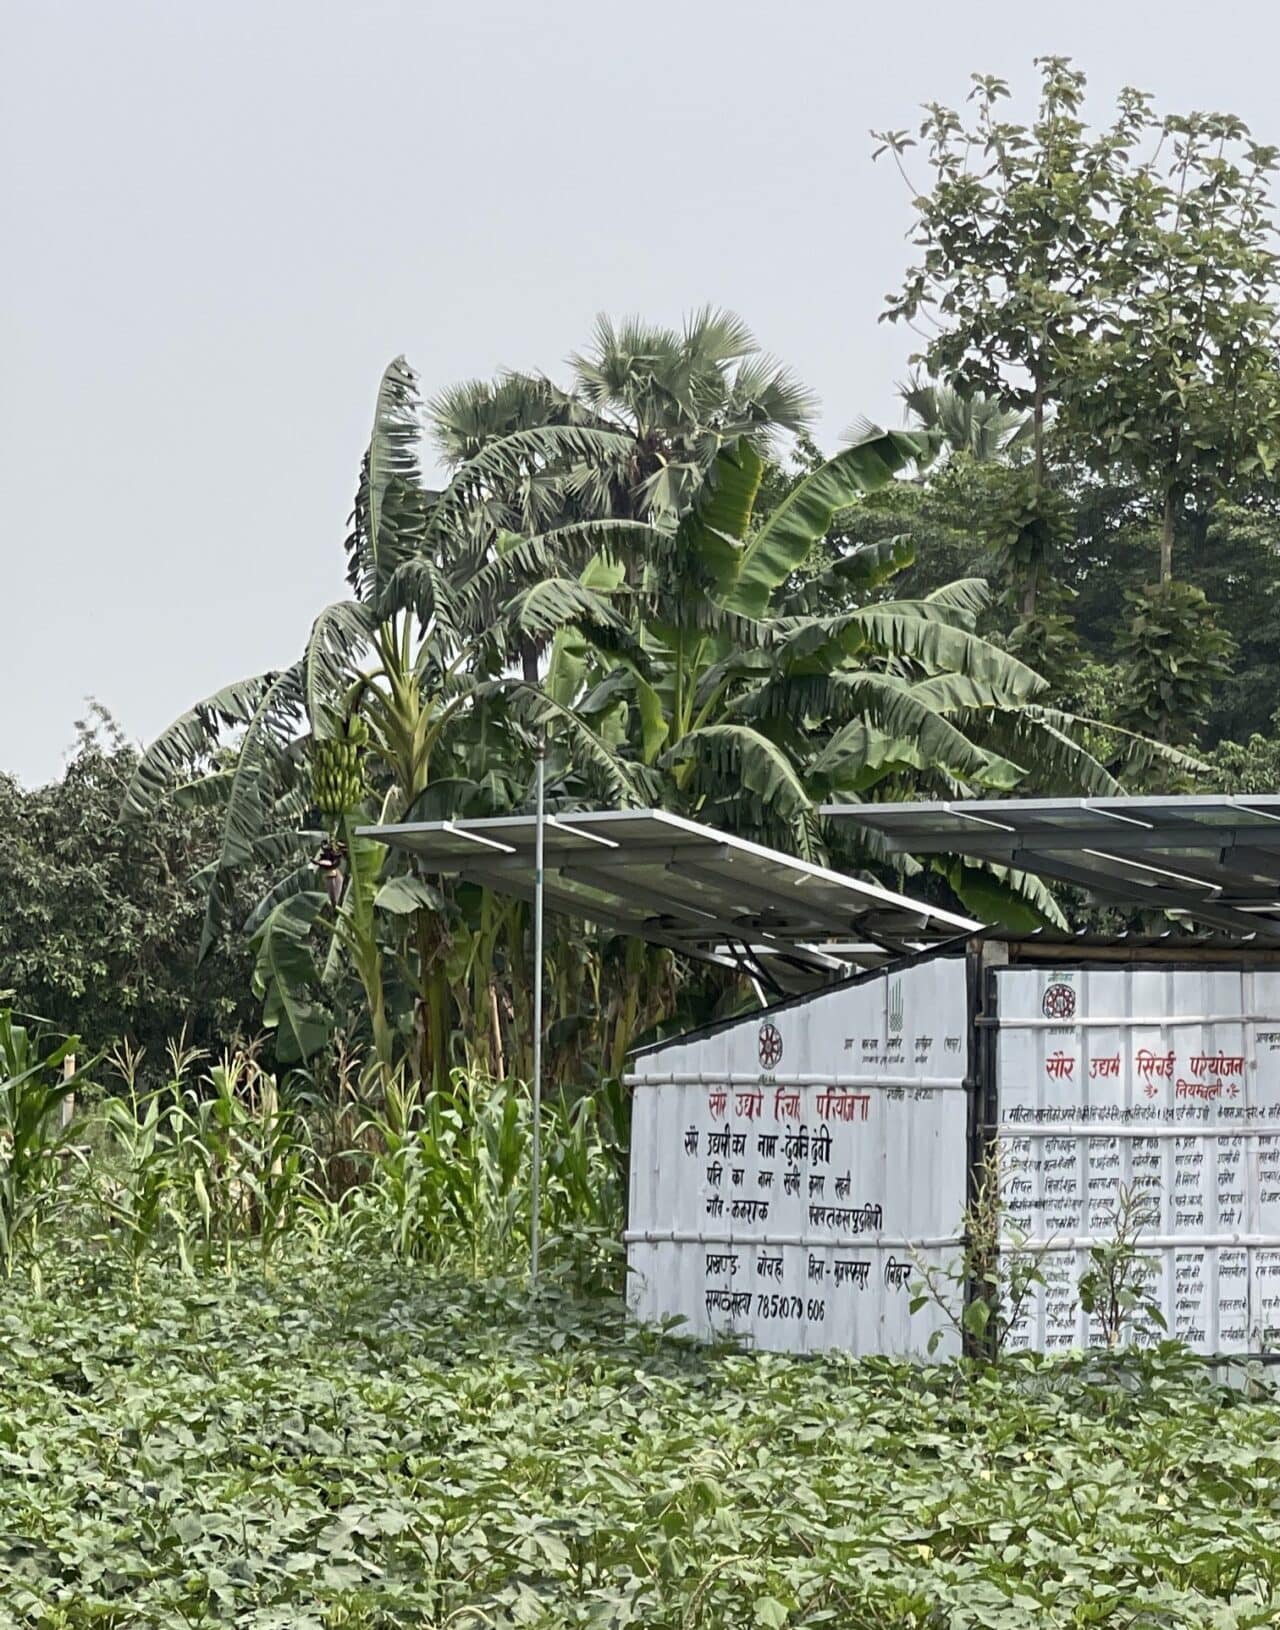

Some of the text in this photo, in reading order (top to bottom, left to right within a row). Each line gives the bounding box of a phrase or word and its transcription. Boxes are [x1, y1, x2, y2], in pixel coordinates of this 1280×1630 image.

[1045, 1050, 1075, 1082] सौर
[757, 1134, 779, 1159] नाम
[732, 1168, 745, 1187] का
